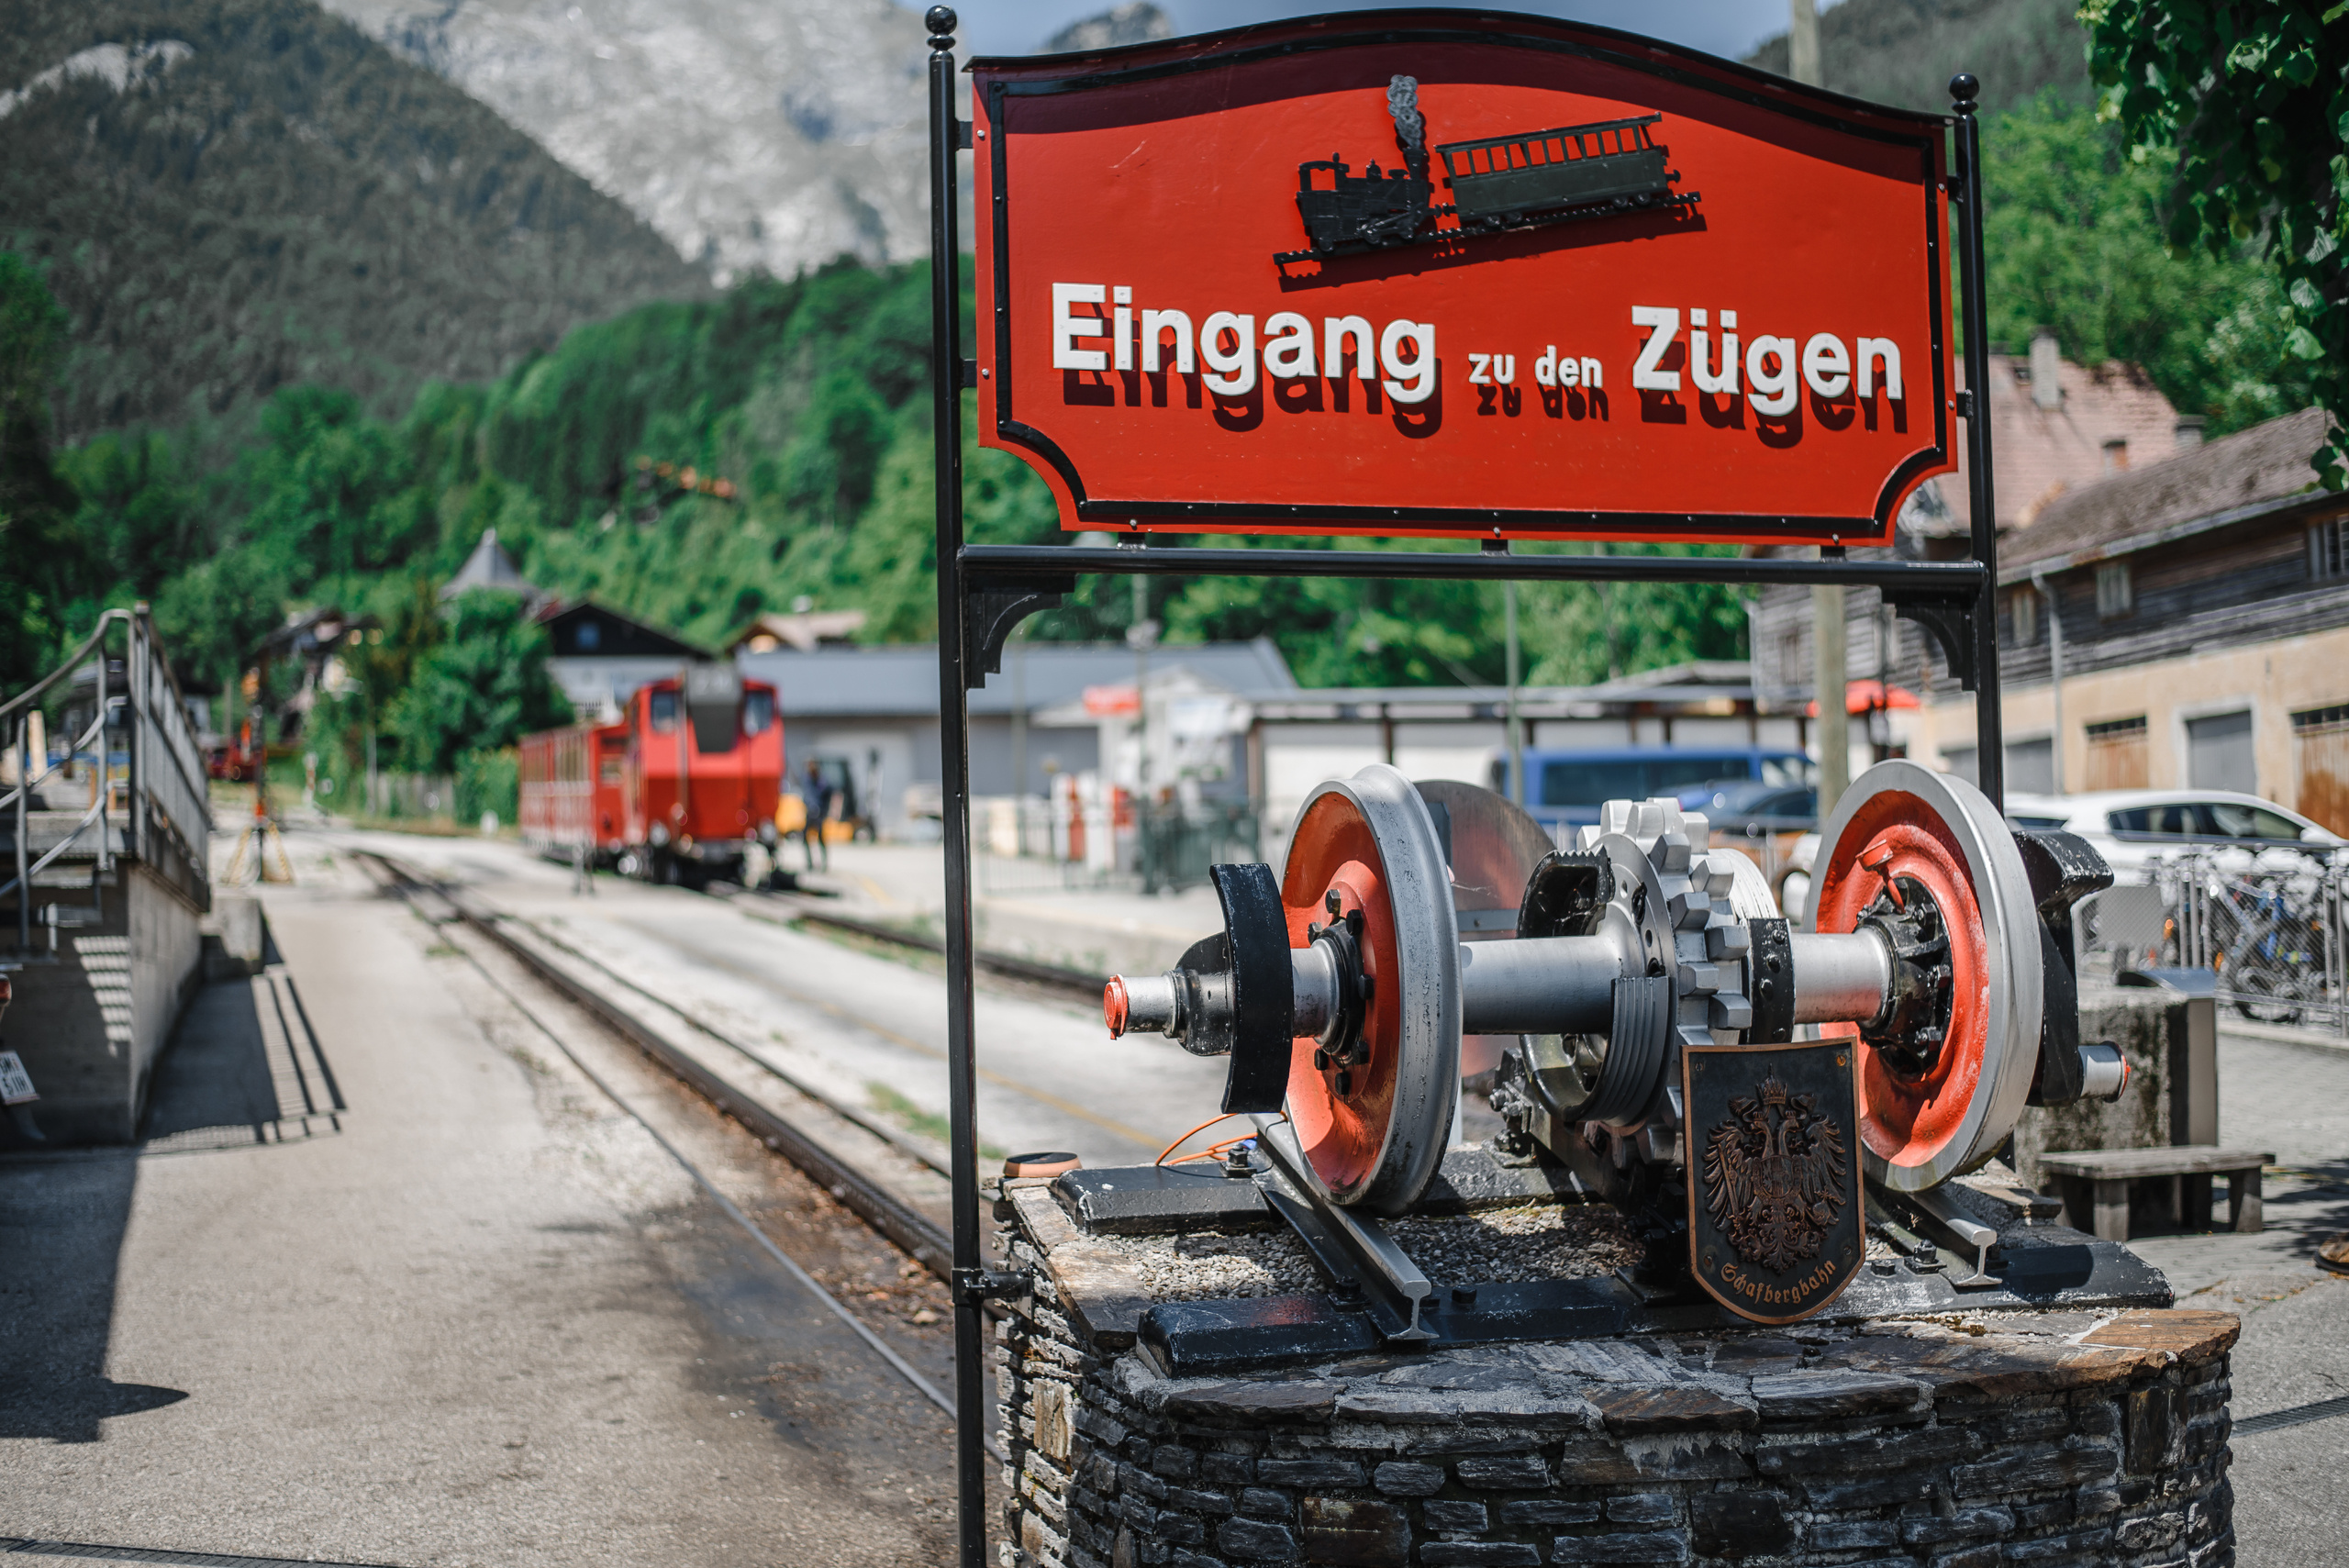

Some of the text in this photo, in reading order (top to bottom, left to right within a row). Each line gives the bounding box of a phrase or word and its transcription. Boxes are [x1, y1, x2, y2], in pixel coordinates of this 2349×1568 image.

[1052, 282, 1903, 417] Eingang zu den Zügen
[1720, 1260, 1836, 1305] Schafbergbahn
